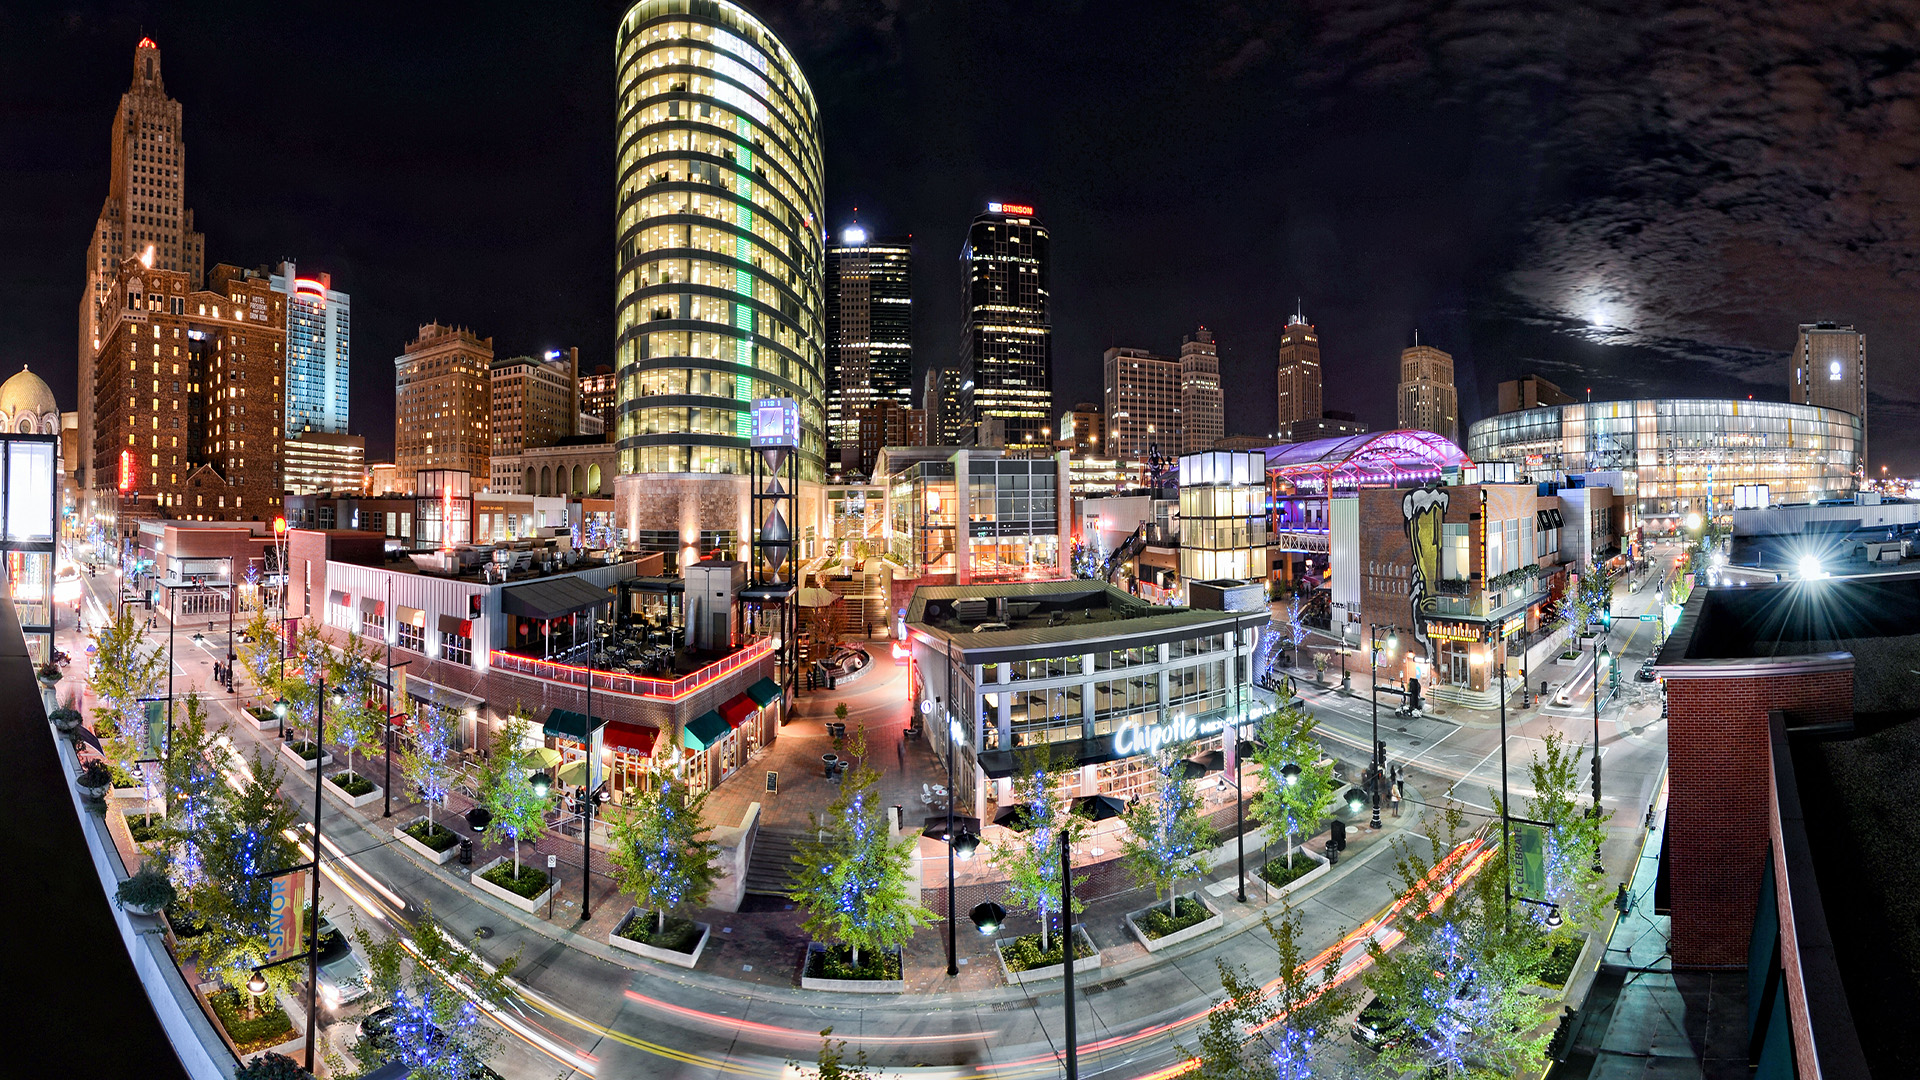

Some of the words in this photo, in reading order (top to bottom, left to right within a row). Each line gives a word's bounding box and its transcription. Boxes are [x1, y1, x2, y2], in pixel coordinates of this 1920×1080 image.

[1003, 204, 1033, 215] STINSON
[252, 296, 265, 304] HOTEL
[1370, 561, 1406, 576] Gordon
[1369, 577, 1408, 594] Biersch
[1427, 623, 1451, 635] Gordon
[1453, 623, 1480, 639] Biersch
[1115, 711, 1196, 756] Chipotle
[1514, 826, 1525, 885] CELEBRATE
[269, 880, 286, 948] SAVOR
